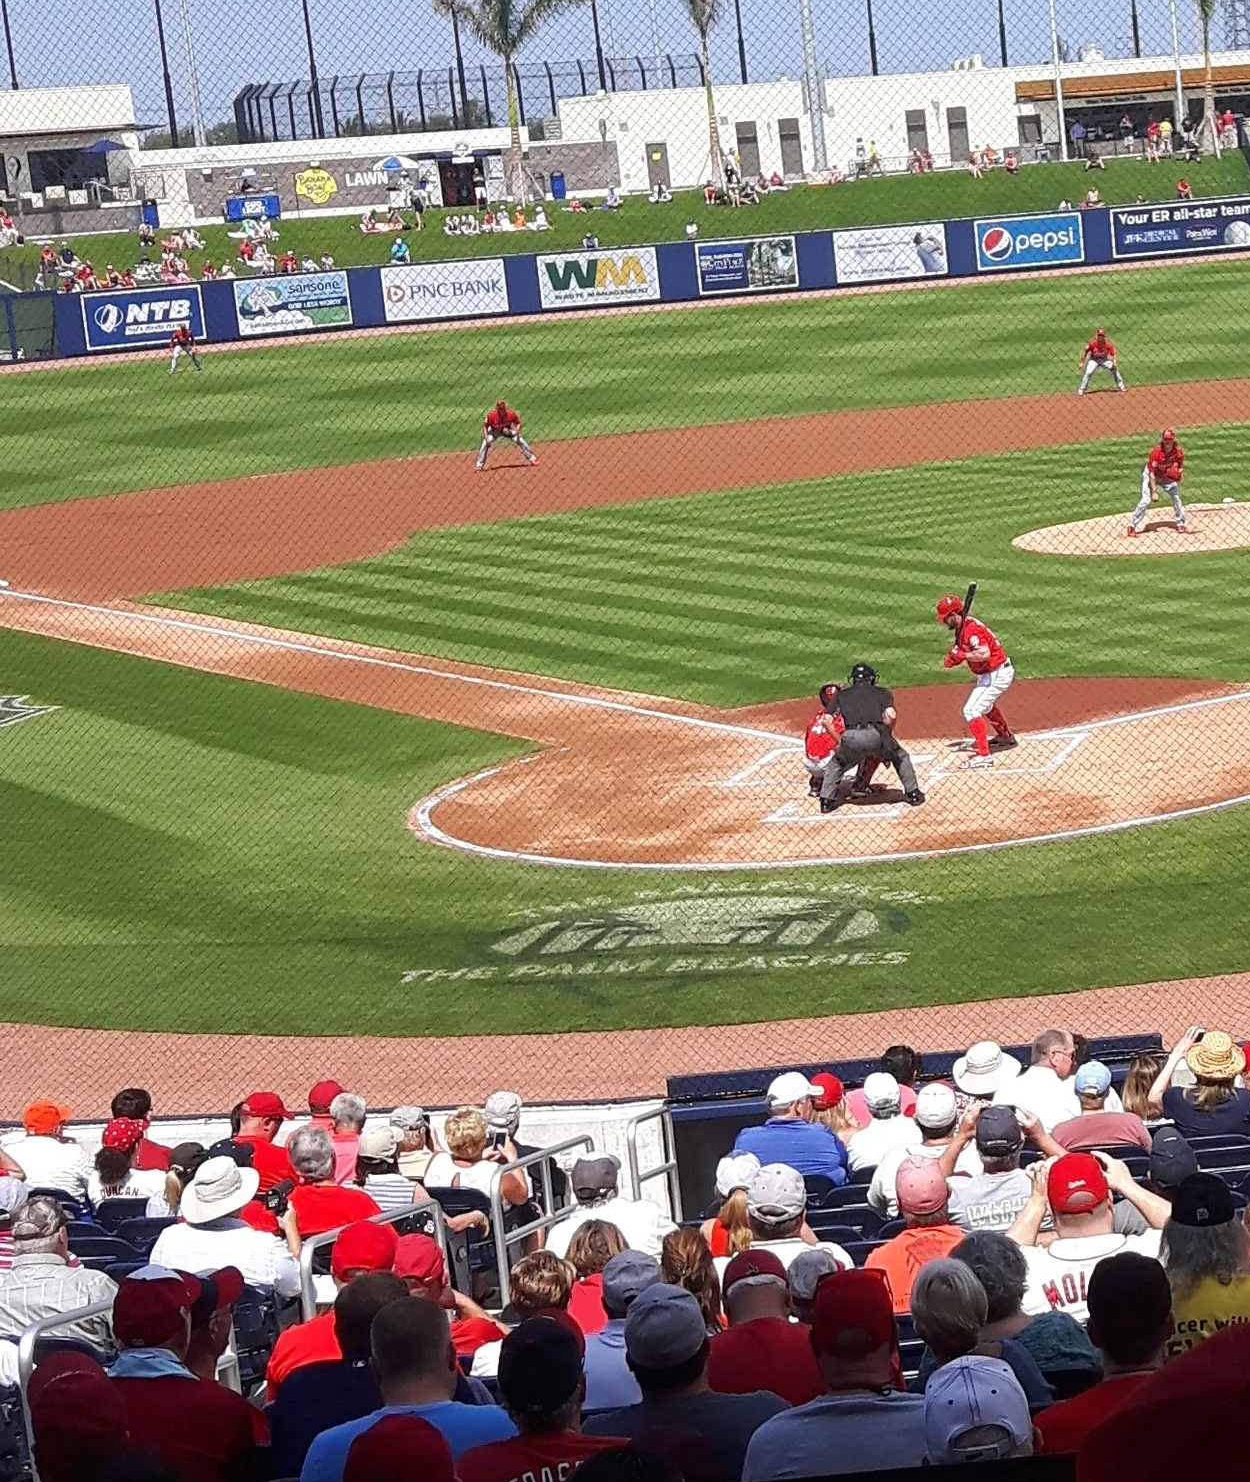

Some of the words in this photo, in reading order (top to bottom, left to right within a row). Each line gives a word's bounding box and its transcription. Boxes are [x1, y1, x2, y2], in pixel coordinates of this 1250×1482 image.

[345, 171, 389, 187] LAWN
[1118, 213, 1149, 225] Your
[1151, 210, 1170, 223] ER
[1173, 207, 1218, 221] all-star
[1016, 227, 1075, 254] pepsi
[544, 256, 648, 291] WM
[287, 280, 341, 294] sansone
[126, 299, 191, 323] NTB
[400, 967, 498, 983] THE
[507, 958, 659, 978] PALM
[665, 951, 912, 972] BEACHES
[100, 1184, 139, 1199] DUNCAN
